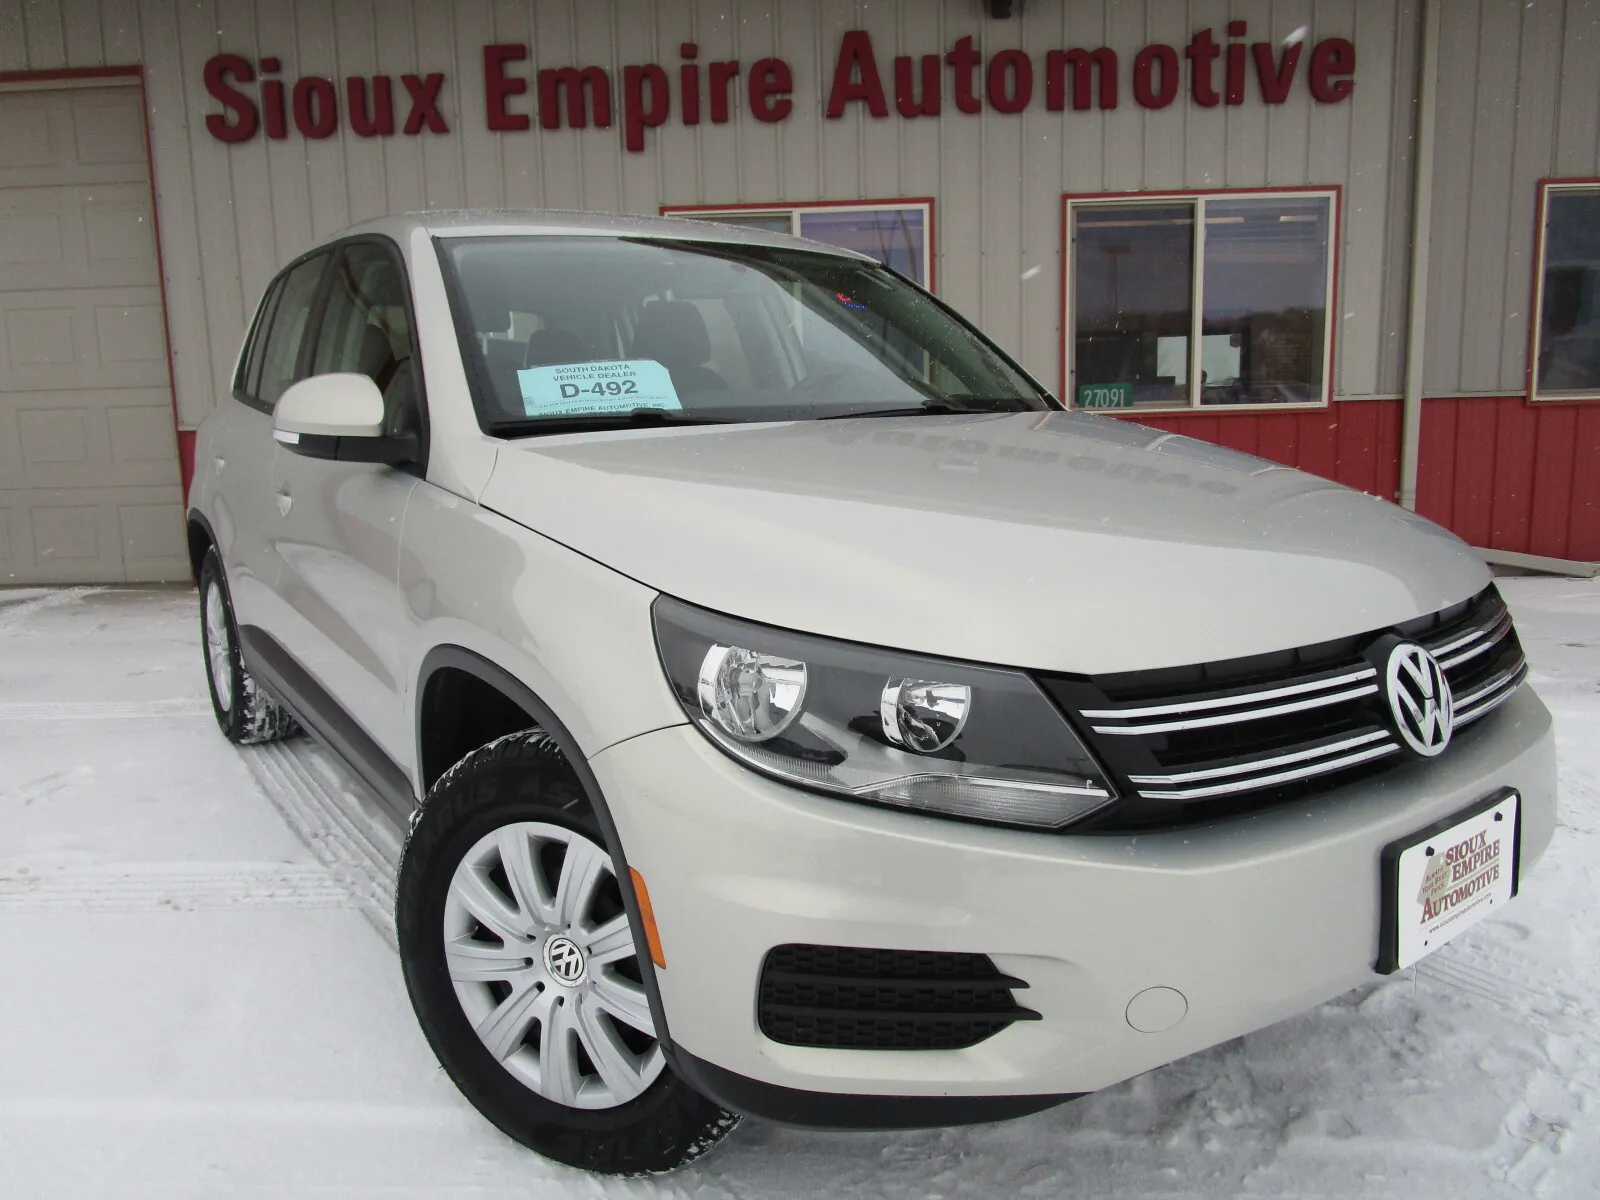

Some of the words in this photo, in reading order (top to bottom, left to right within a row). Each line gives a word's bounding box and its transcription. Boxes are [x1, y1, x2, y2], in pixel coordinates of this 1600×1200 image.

[203, 53, 449, 143] Sioux
[483, 43, 793, 153] Empire
[826, 20, 1357, 119] Automotive
[552, 372, 594, 382] VEHICLE
[597, 371, 636, 379] DEALER
[555, 366, 589, 374] SOUTH
[591, 364, 630, 372] DAKOTA
[559, 379, 639, 399] D-492
[1083, 388, 1125, 408] 27091
[565, 405, 596, 414] EMPIRE
[1445, 829, 1488, 867] SIOUX
[1451, 839, 1500, 883] EMPIRE
[1420, 864, 1500, 925] AUTOMOTIVE
